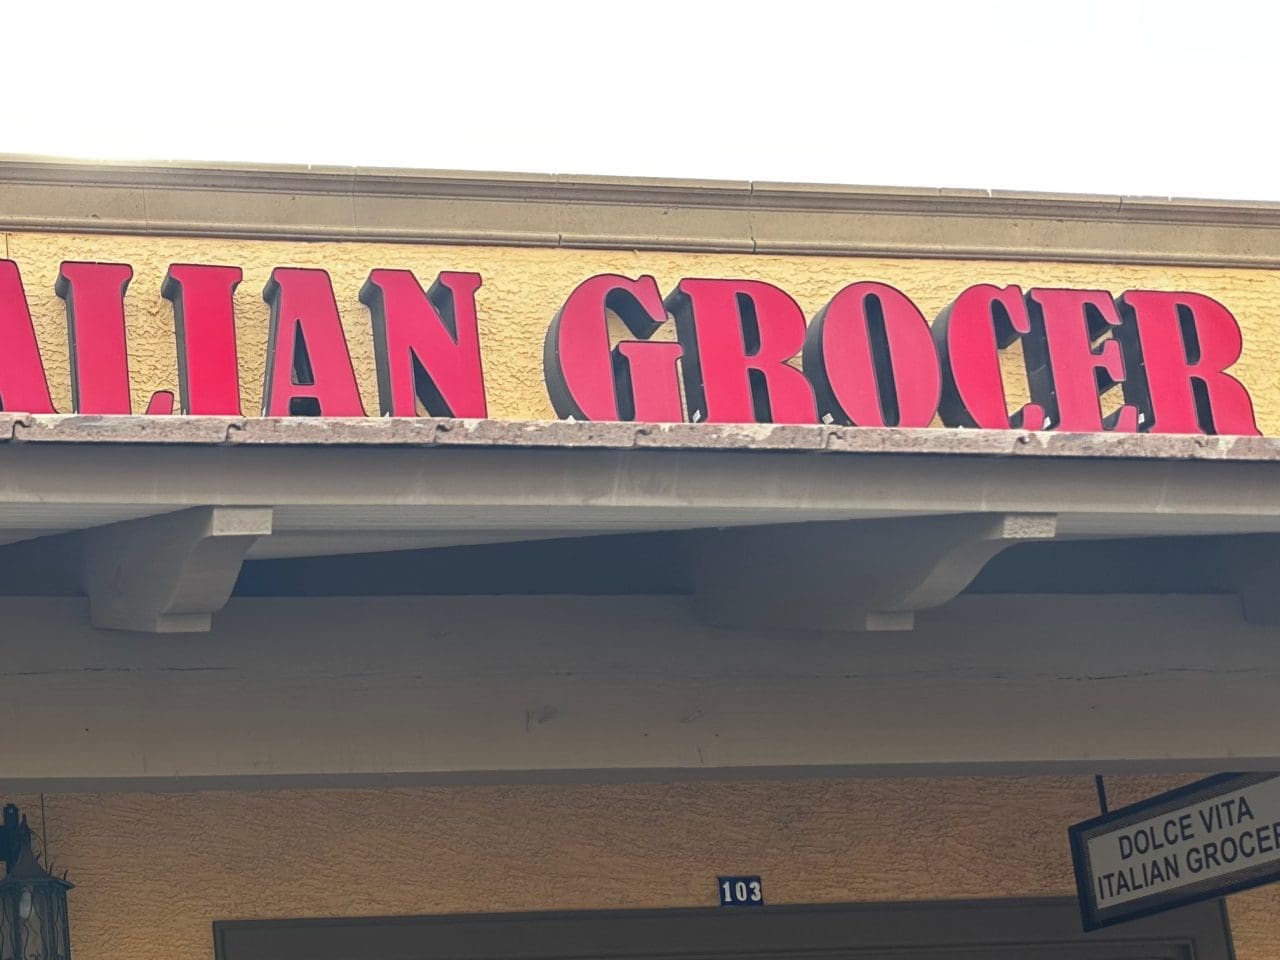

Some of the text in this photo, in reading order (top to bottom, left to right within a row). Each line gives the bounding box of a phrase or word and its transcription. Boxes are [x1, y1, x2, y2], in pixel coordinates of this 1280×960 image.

[544, 273, 1263, 437] GROCER
[1118, 796, 1254, 861] DOLCE VITA
[722, 881, 762, 902] 103
[1097, 853, 1180, 901] ITALIAN
